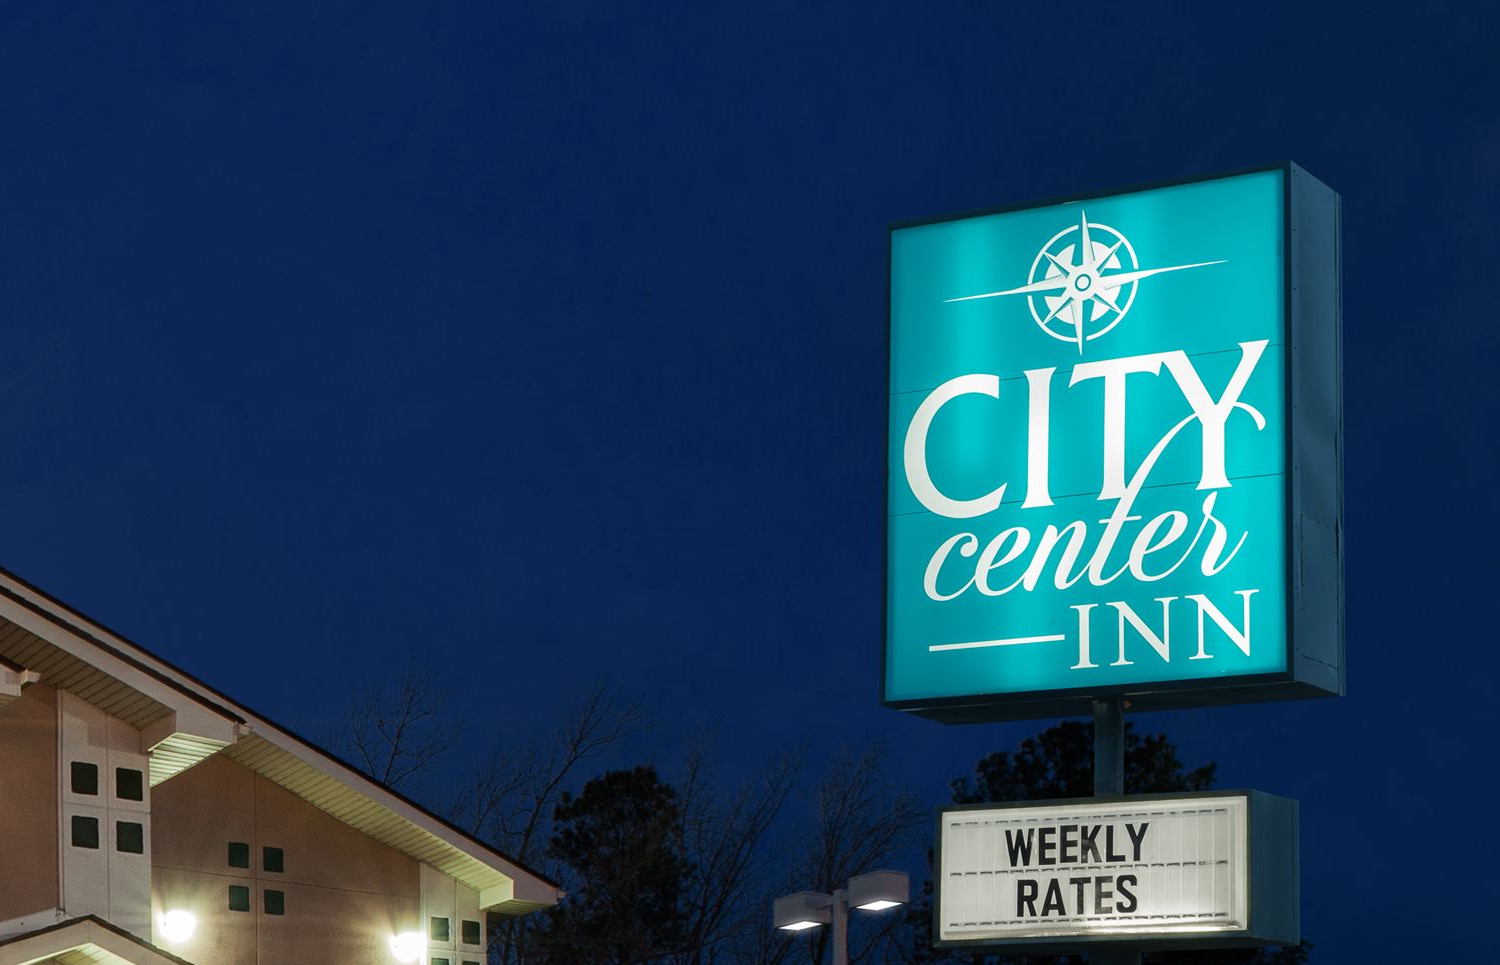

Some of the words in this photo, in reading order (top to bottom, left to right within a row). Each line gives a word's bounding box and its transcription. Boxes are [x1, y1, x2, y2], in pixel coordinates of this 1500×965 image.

[903, 339, 1269, 519] CITY
[923, 412, 1248, 601] center
[1070, 589, 1259, 669] INN
[1005, 822, 1150, 867] WEEKLY
[1016, 874, 1138, 917] RATES
